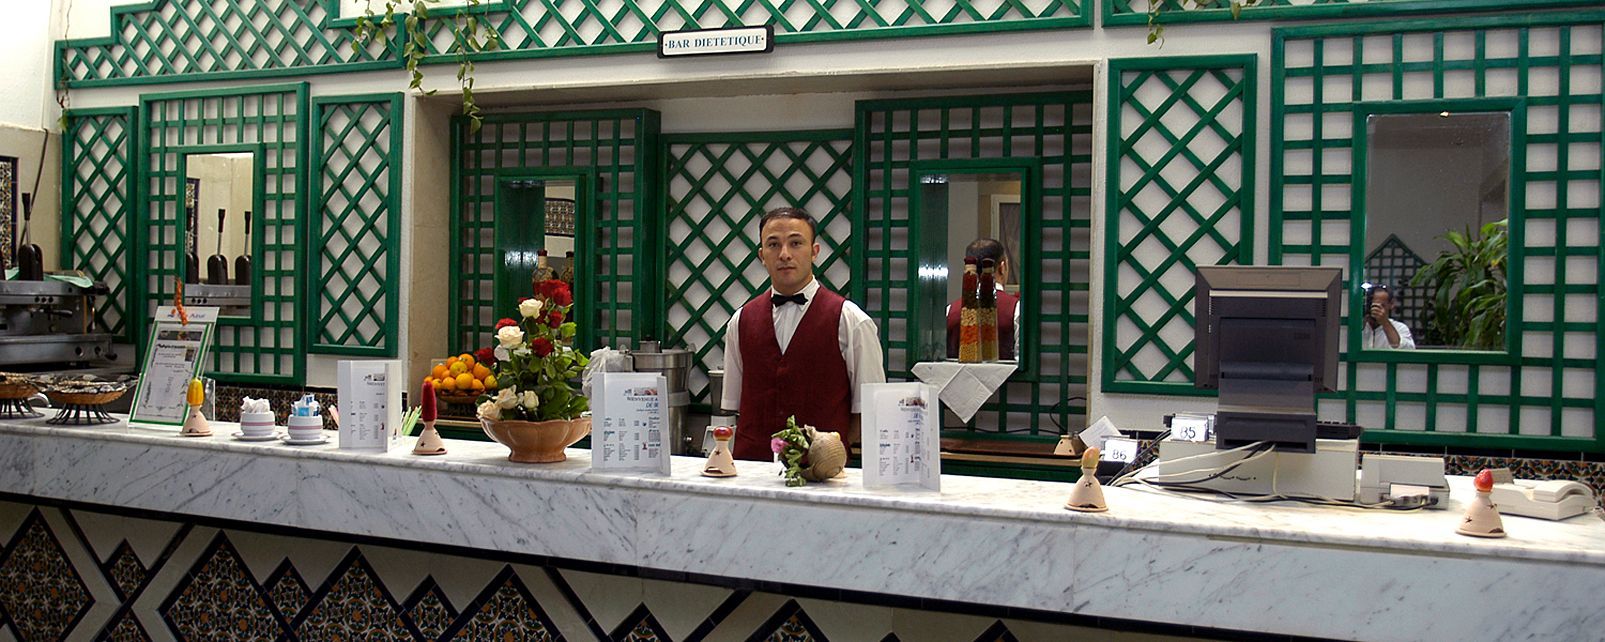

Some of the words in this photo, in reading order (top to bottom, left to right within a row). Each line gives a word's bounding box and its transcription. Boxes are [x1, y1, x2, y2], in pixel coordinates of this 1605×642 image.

[668, 39, 690, 49] BAR
[694, 34, 761, 48] DIETETIQUE
[1180, 426, 1196, 439] 85
[1112, 449, 1127, 460] 86
